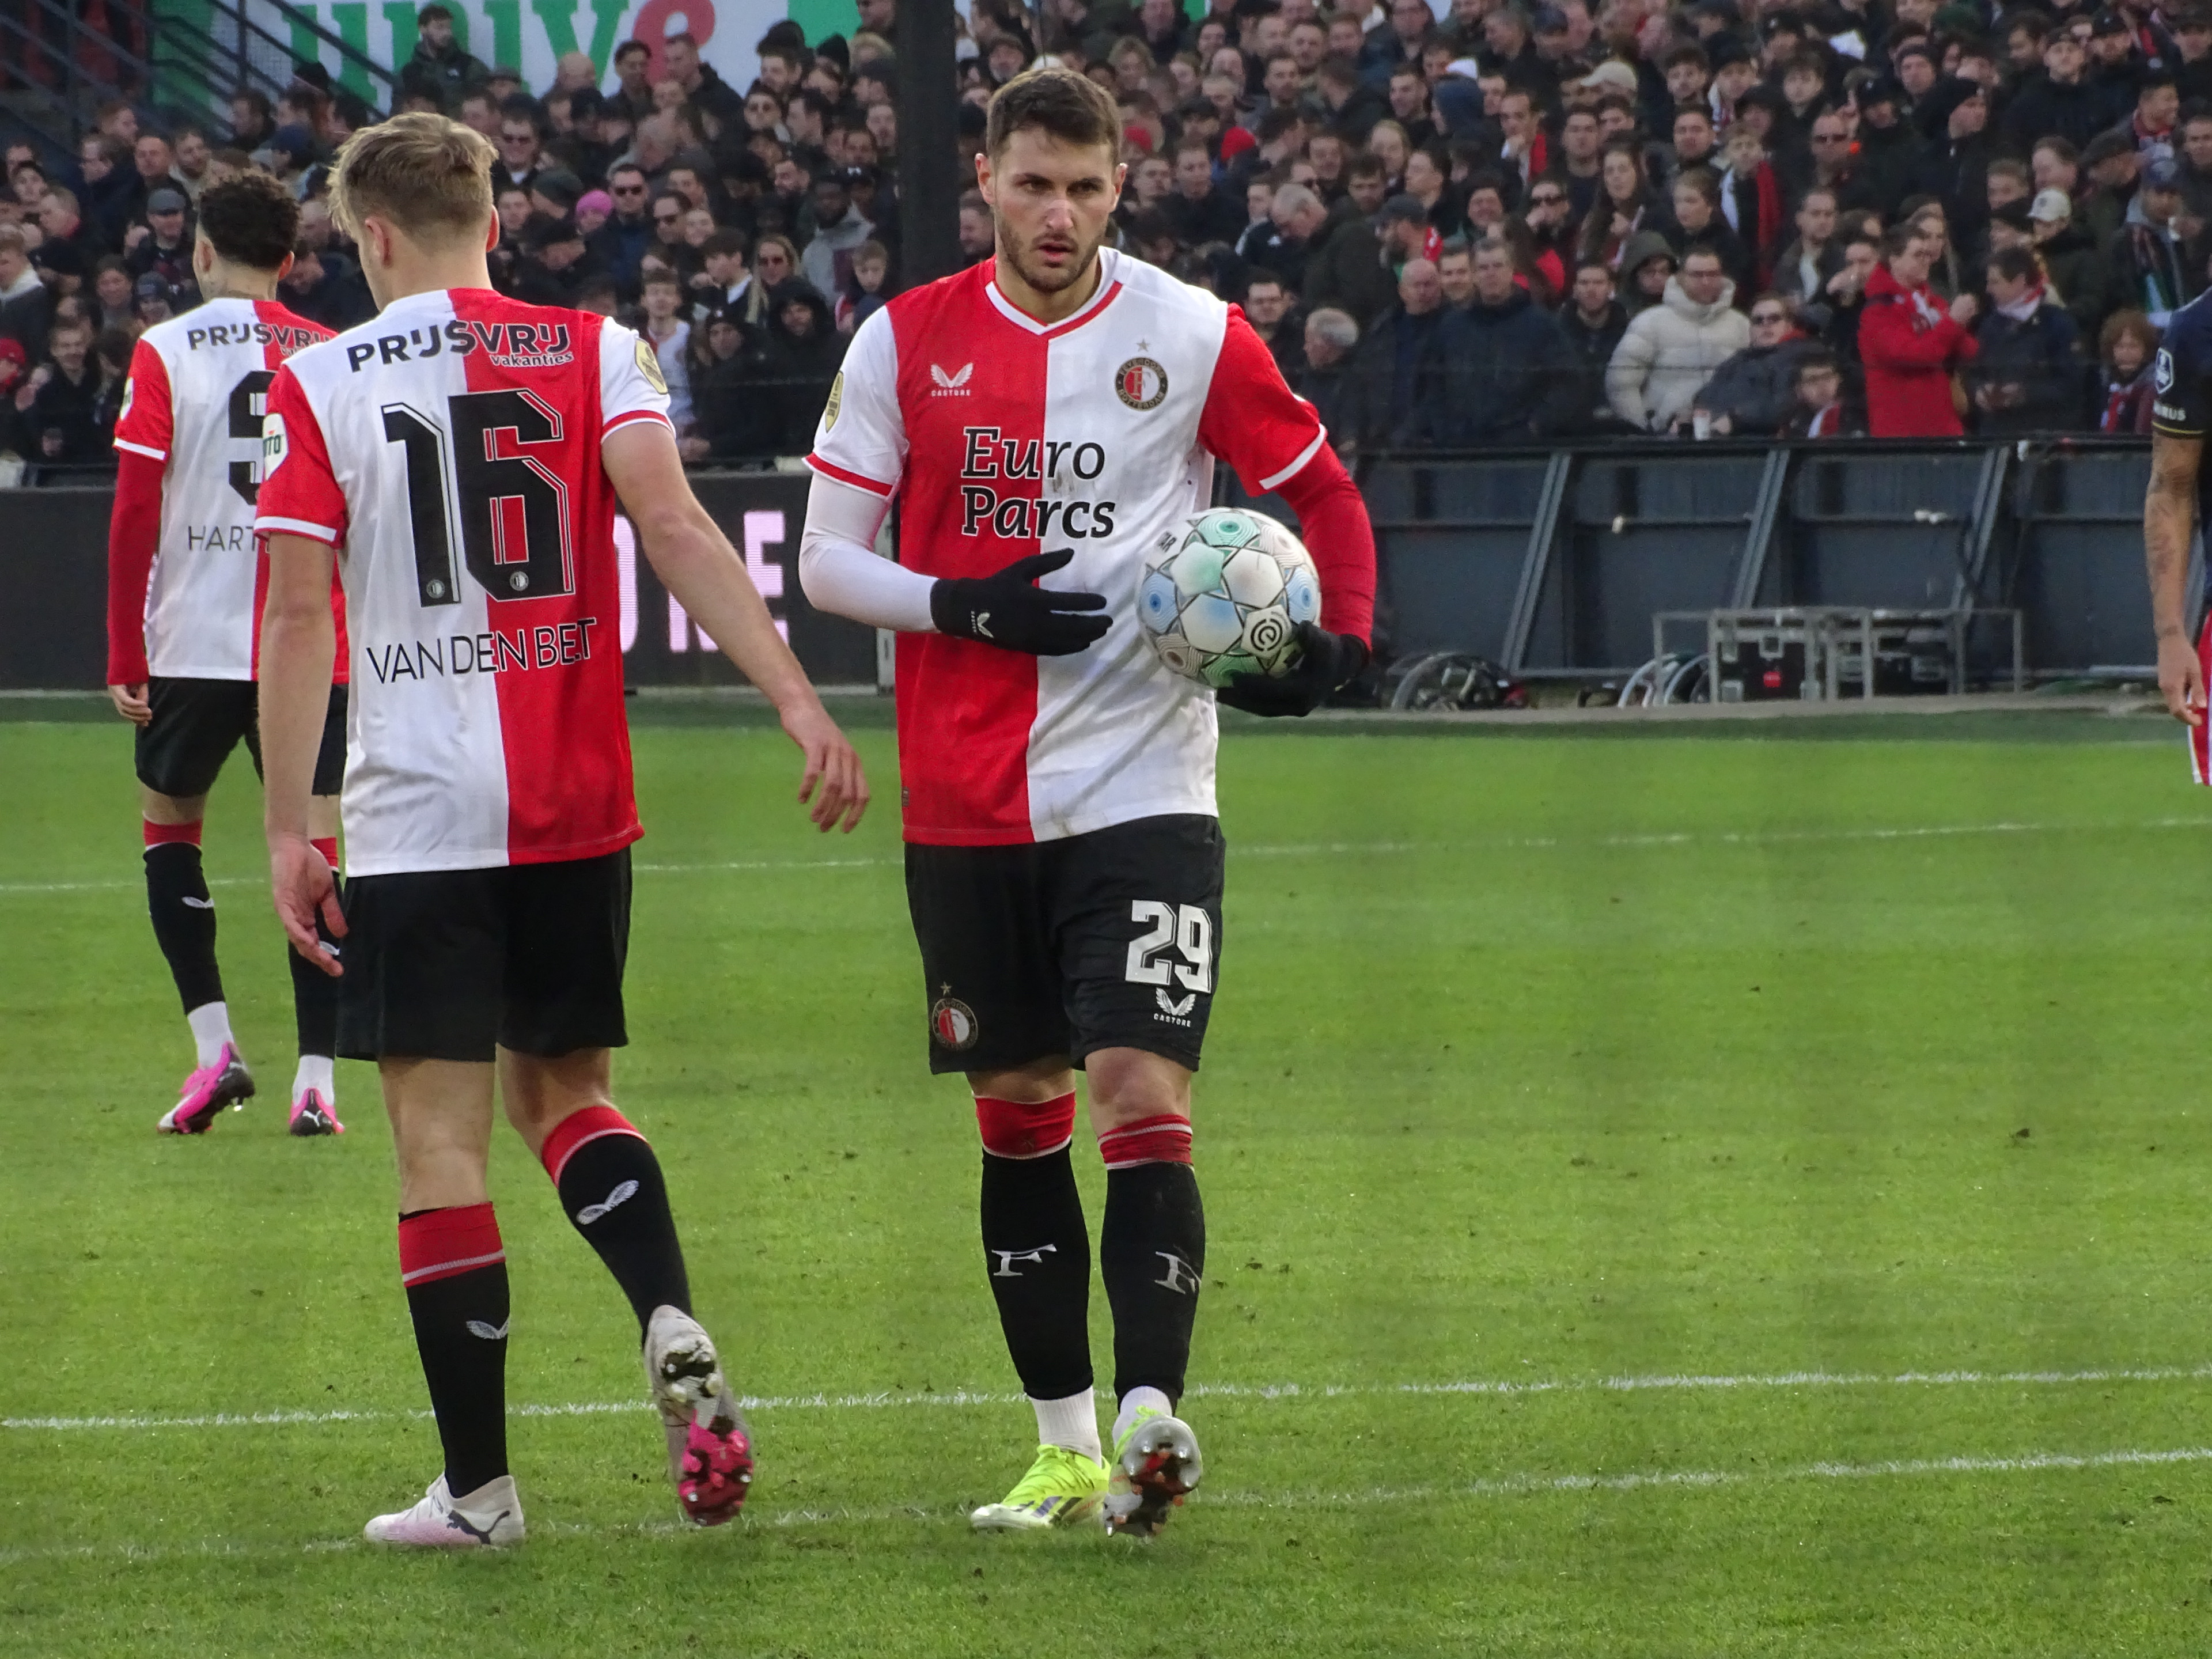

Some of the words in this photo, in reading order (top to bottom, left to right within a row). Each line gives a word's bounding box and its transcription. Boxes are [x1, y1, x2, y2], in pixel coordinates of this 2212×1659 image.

[490, 351, 574, 368] vakanties
[961, 426, 1105, 480] Euro
[381, 388, 575, 608] 16
[961, 485, 1116, 539] Parcs
[366, 638, 444, 684] VAN
[451, 628, 529, 676] DEN
[1125, 899, 1213, 994] 29
[1153, 1012, 1192, 1028] CASTORE
